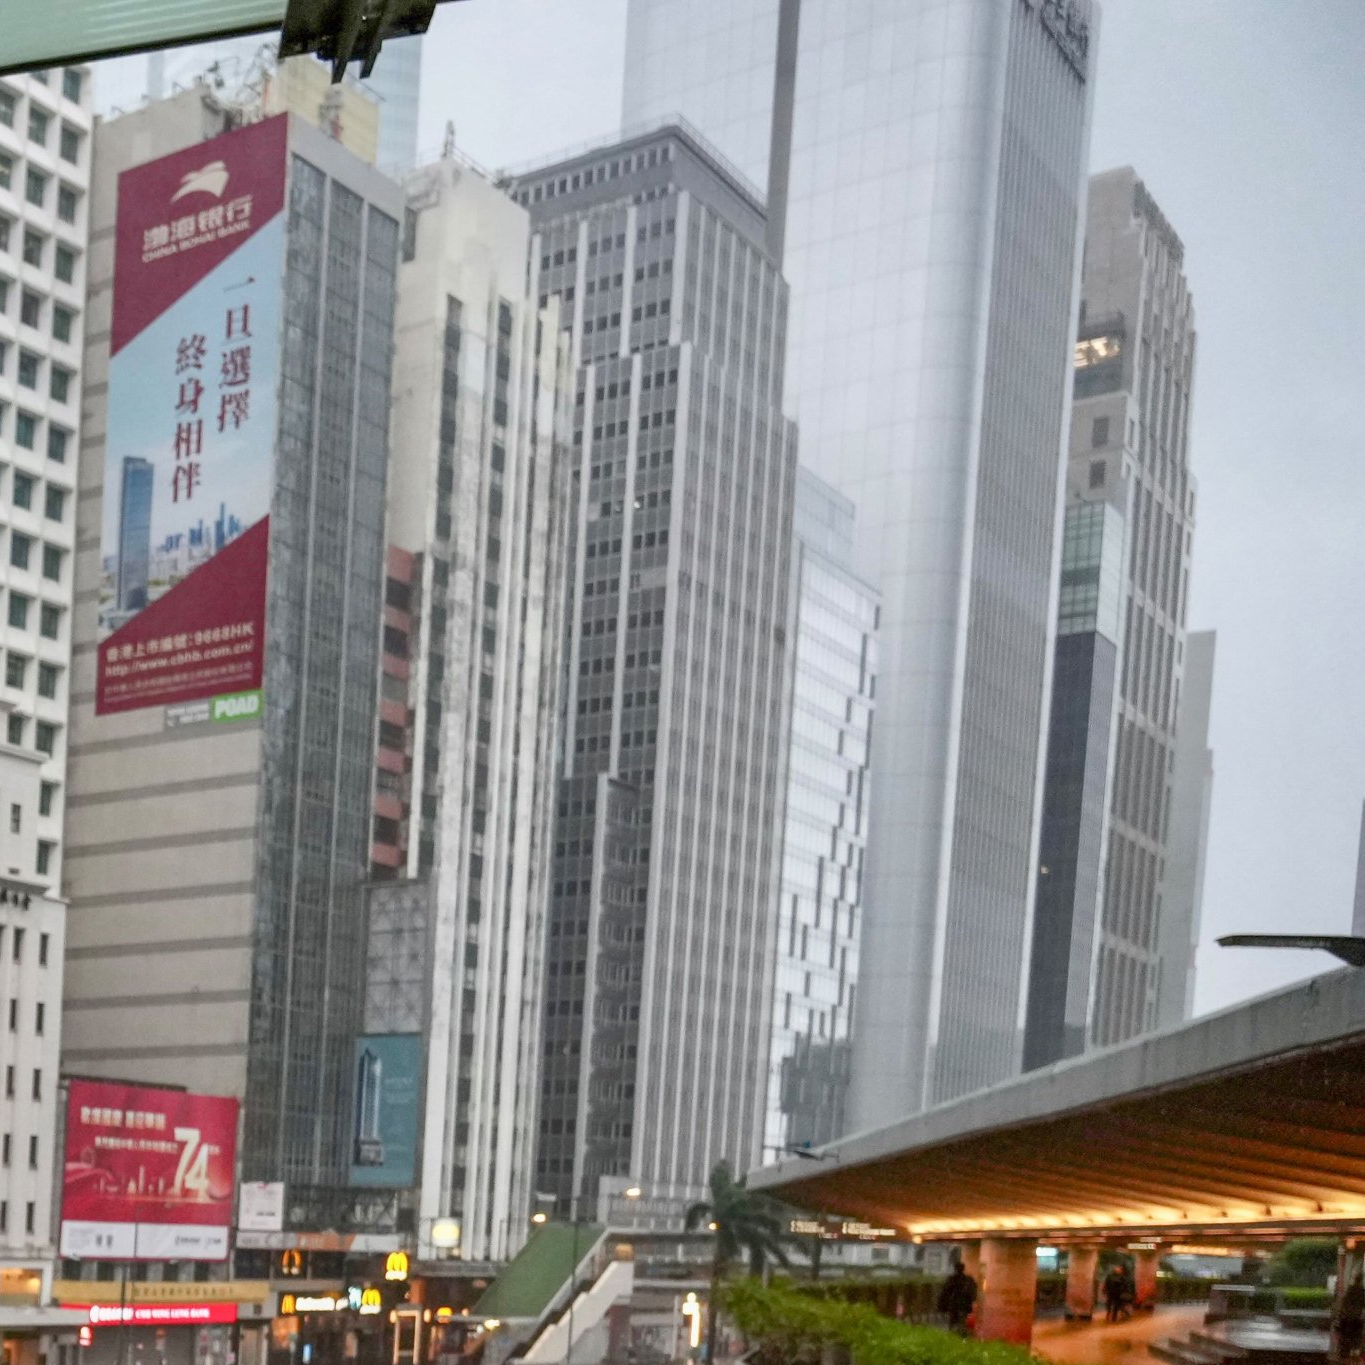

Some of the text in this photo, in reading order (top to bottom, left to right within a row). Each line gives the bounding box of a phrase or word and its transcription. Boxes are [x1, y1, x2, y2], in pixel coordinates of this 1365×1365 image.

[218, 277, 255, 433] 一旦選擇
[171, 334, 206, 502] 終身相伴
[214, 695, 259, 719] POAD
[174, 1126, 209, 1202] 74
